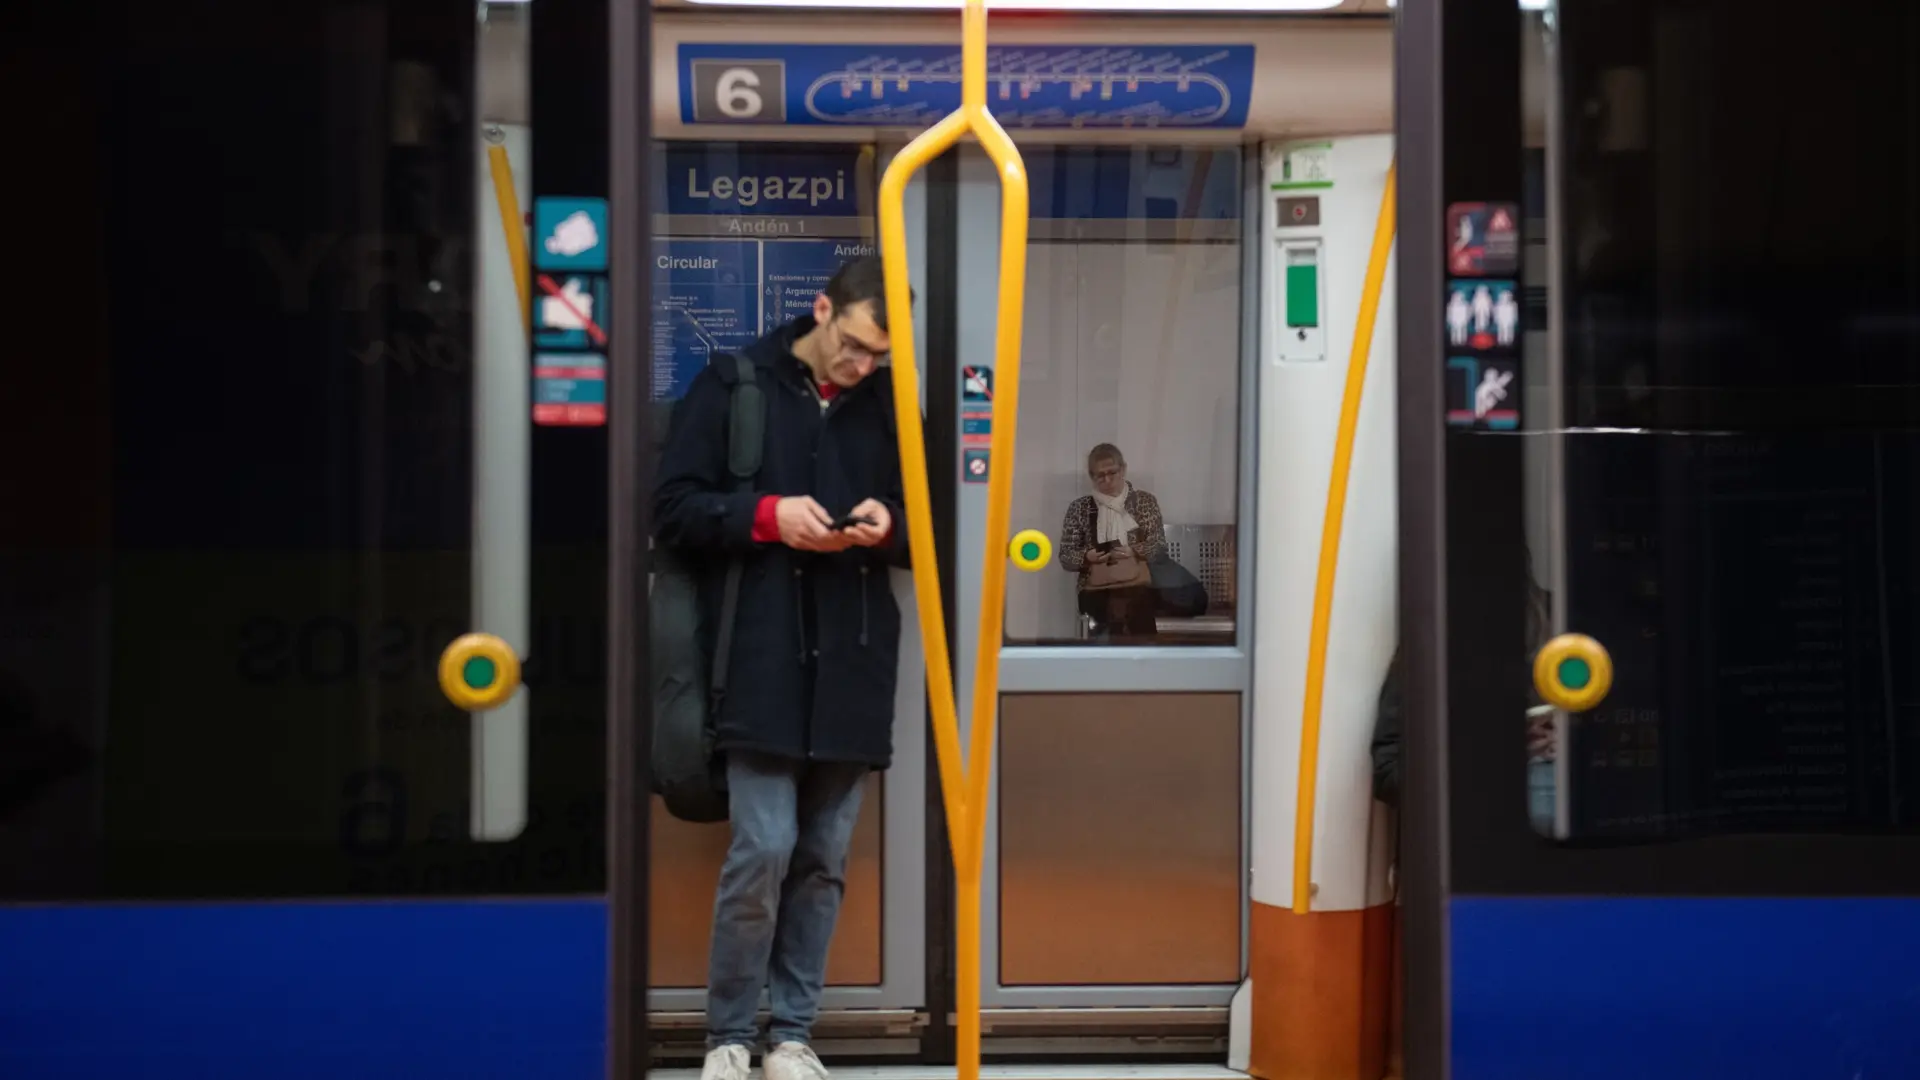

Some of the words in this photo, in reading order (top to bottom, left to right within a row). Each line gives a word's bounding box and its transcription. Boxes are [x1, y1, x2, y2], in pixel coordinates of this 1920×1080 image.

[715, 67, 763, 118] 6
[688, 168, 845, 206] Legazpi
[728, 217, 790, 234] Andén
[797, 220, 806, 234] 1
[656, 255, 719, 270] Circular
[769, 274, 806, 282] Estaciones
